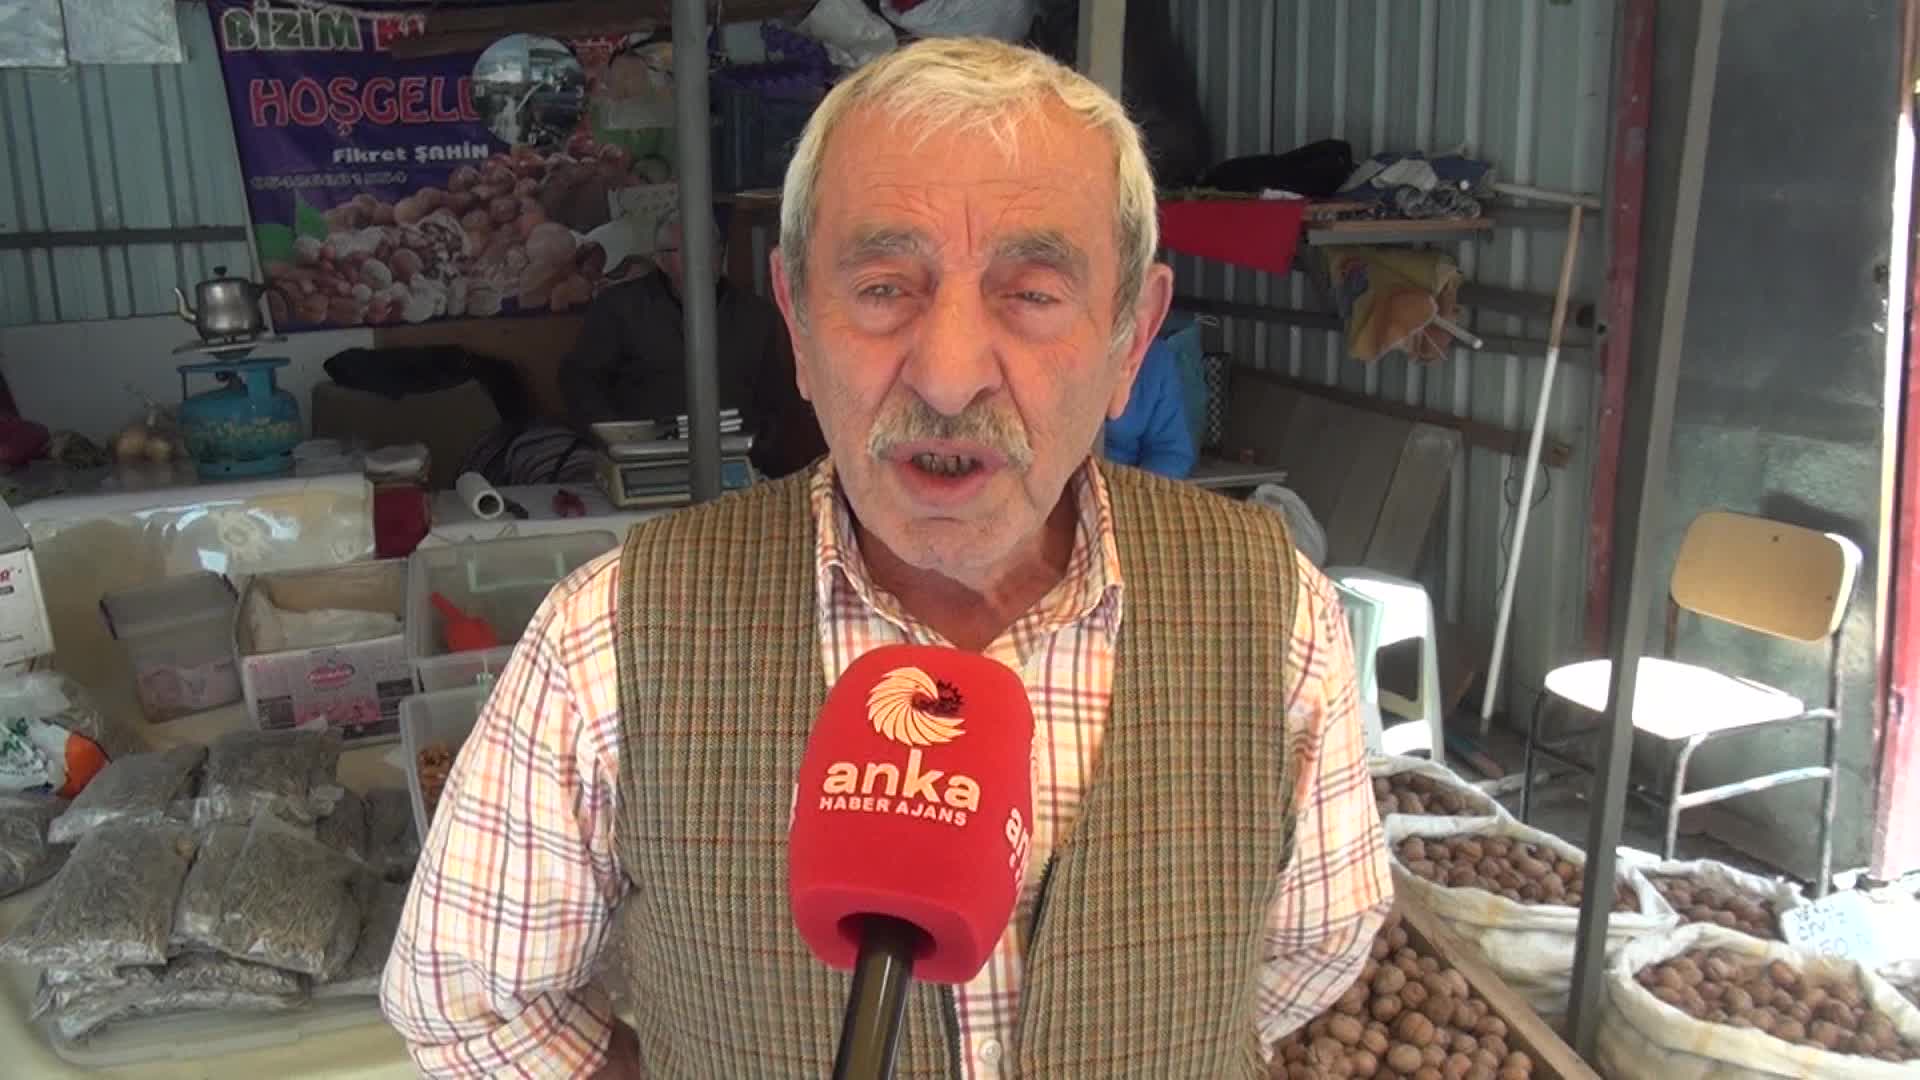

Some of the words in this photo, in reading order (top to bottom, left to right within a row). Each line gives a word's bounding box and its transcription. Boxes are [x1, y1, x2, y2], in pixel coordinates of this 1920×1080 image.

[223, 1, 363, 51] BİZİM
[332, 147, 408, 164] Fikret
[414, 141, 489, 163] ŞAHİN
[822, 749, 981, 812] anka
[819, 797, 889, 812] HABER
[895, 801, 967, 827] AJANS
